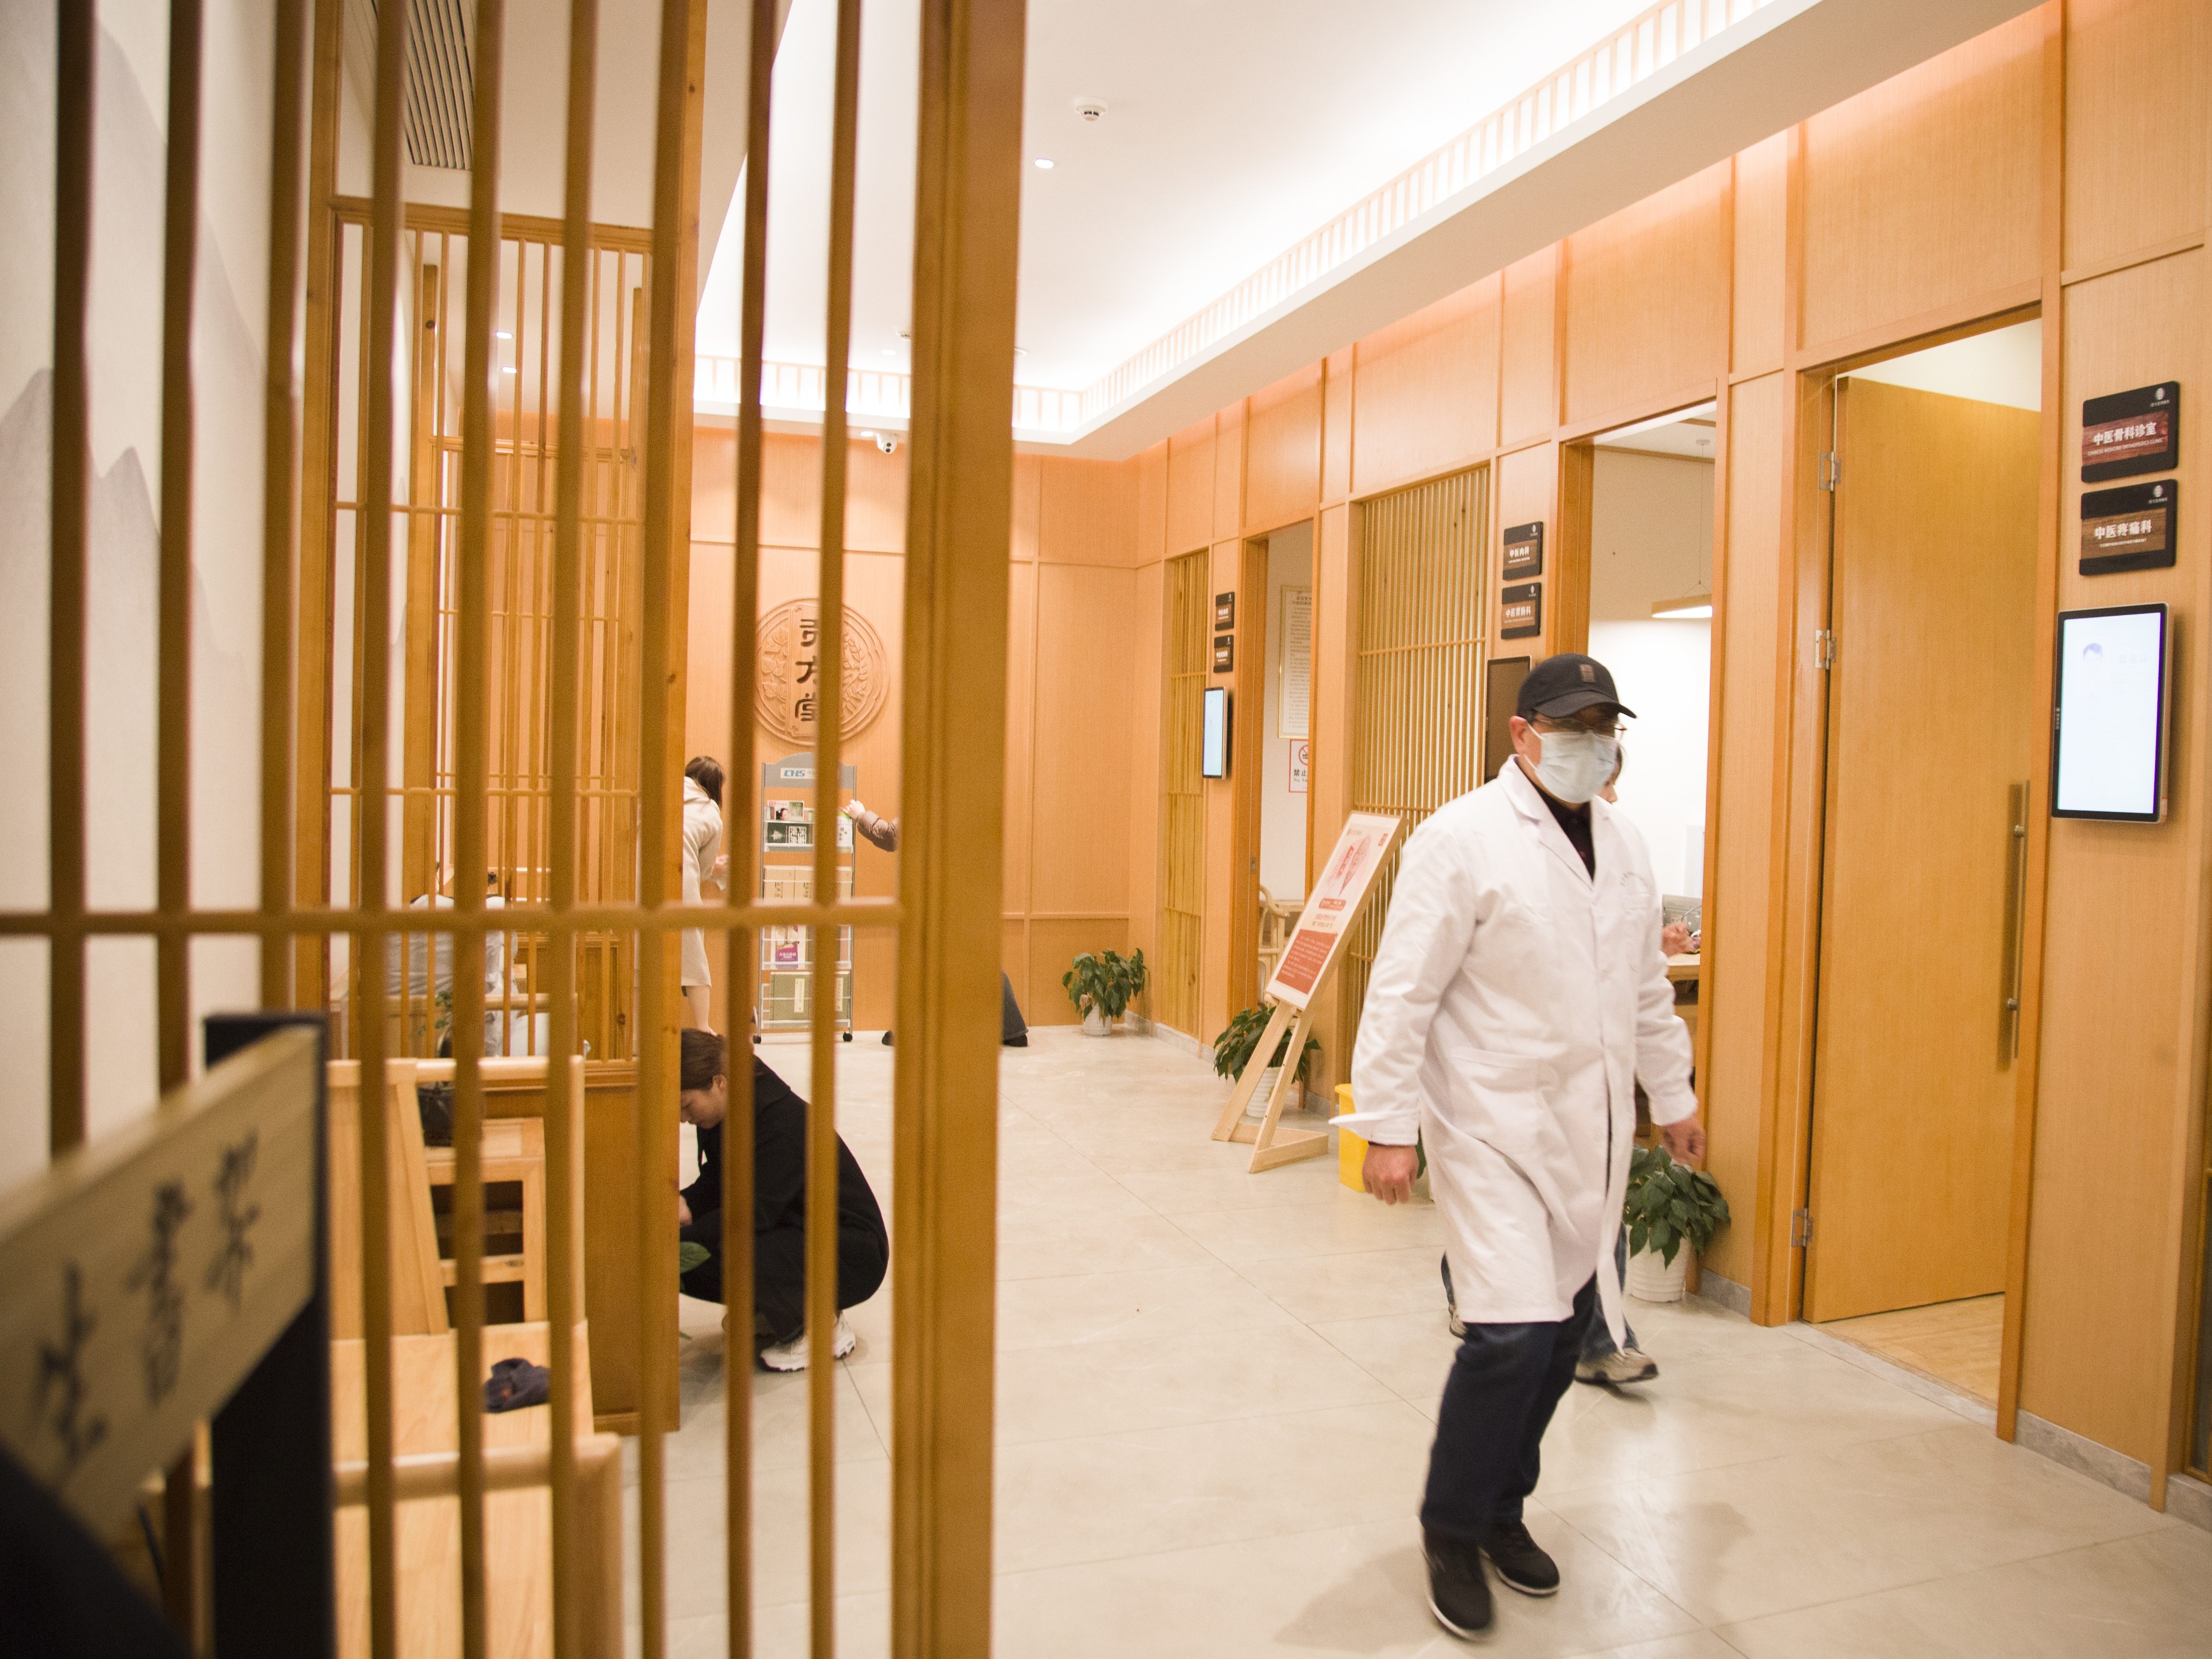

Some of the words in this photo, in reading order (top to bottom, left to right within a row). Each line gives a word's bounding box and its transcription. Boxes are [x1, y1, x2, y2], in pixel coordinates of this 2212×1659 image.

[2093, 422, 2157, 445] 中医骨科诊室
[2095, 520, 2152, 540] 中医疼痛科
[1509, 545, 1530, 557] 中医内科
